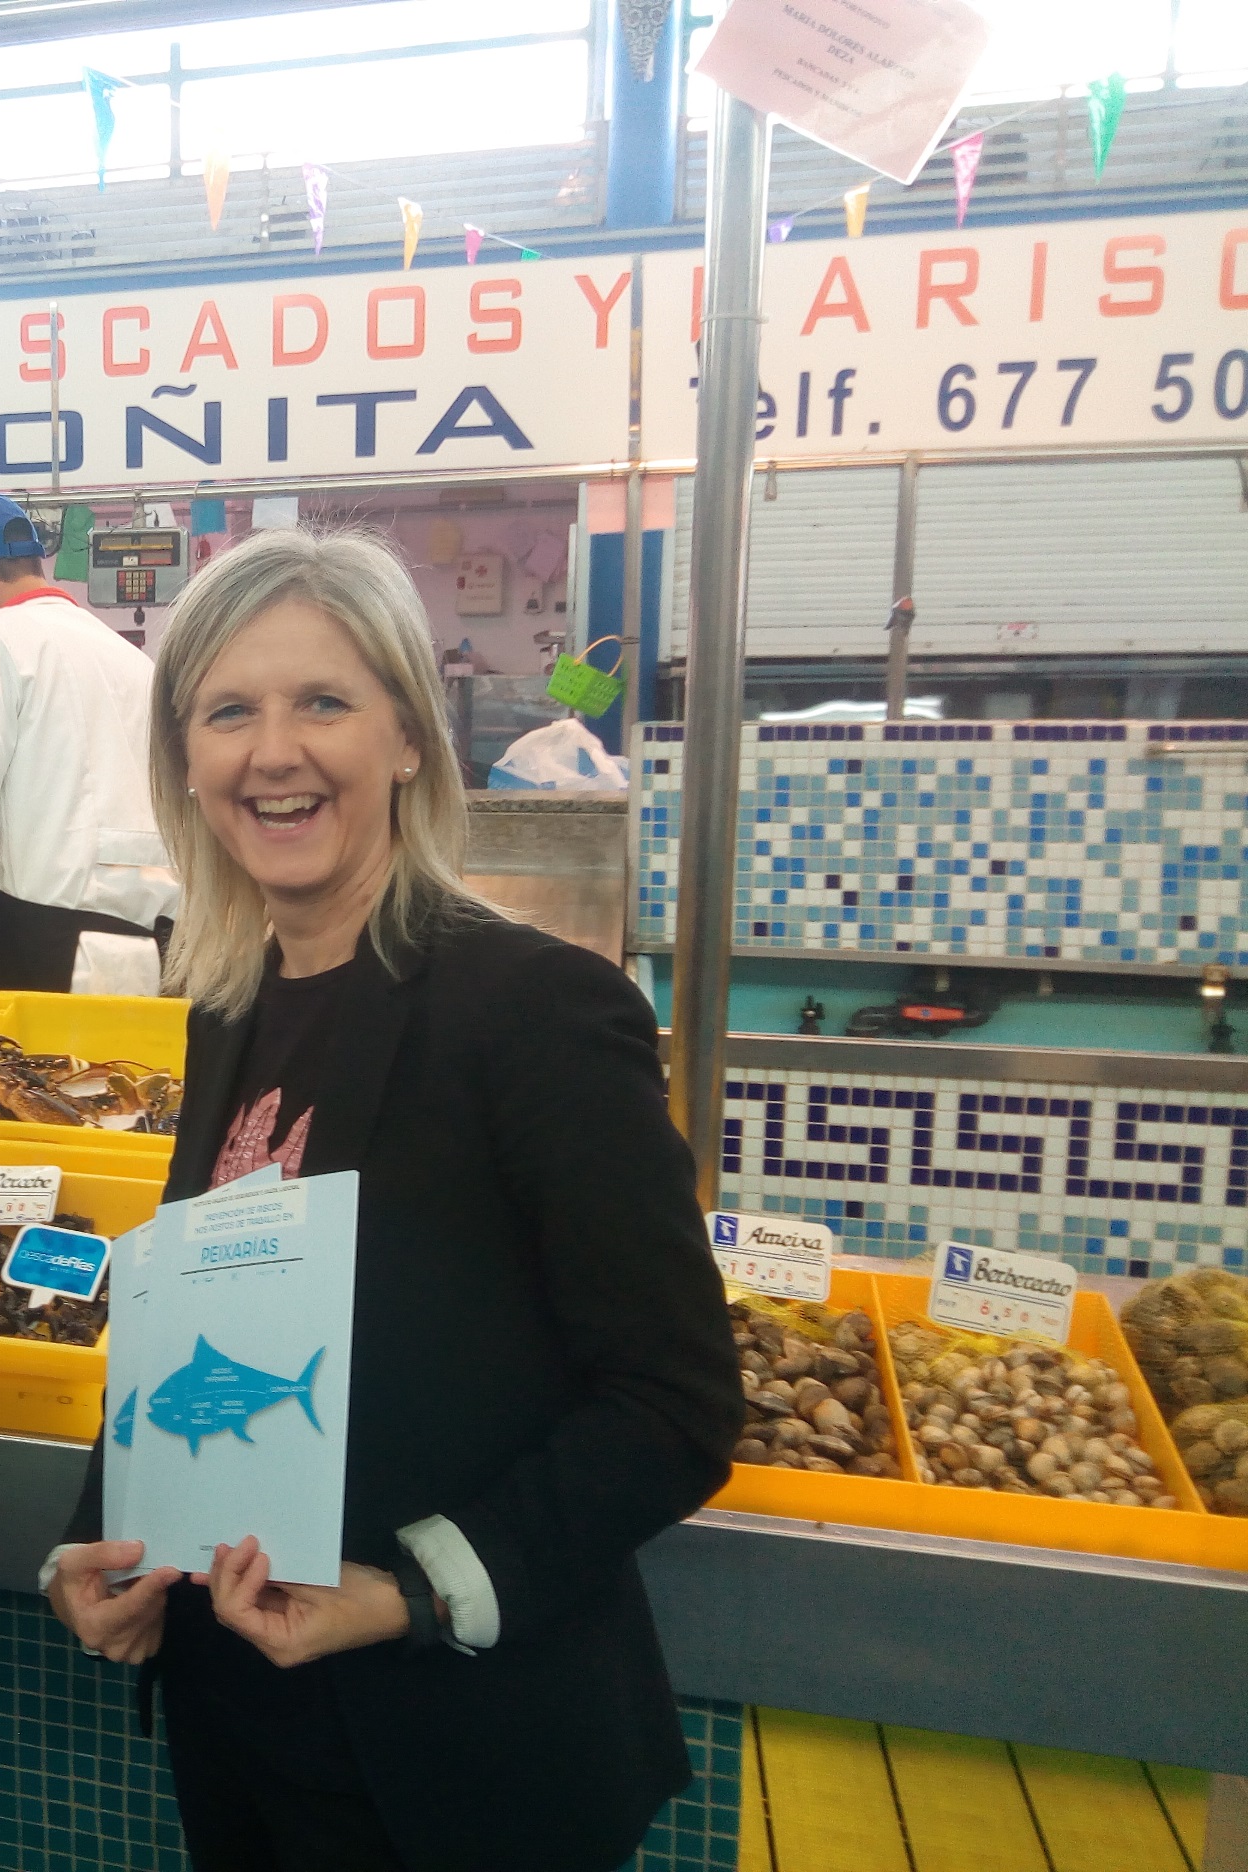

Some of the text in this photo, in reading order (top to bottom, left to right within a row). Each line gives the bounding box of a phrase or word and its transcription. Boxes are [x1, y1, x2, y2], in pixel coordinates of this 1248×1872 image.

[574, 272, 633, 350] Y
[690, 228, 1248, 343] ARIS
[689, 347, 1248, 442] elf. 677 50
[200, 1235, 280, 1264] PEIXARÍAS
[741, 1225, 825, 1251] Ameixa
[17, 1249, 97, 1273] pescadeRías
[973, 1256, 1073, 1298] Berberecho
